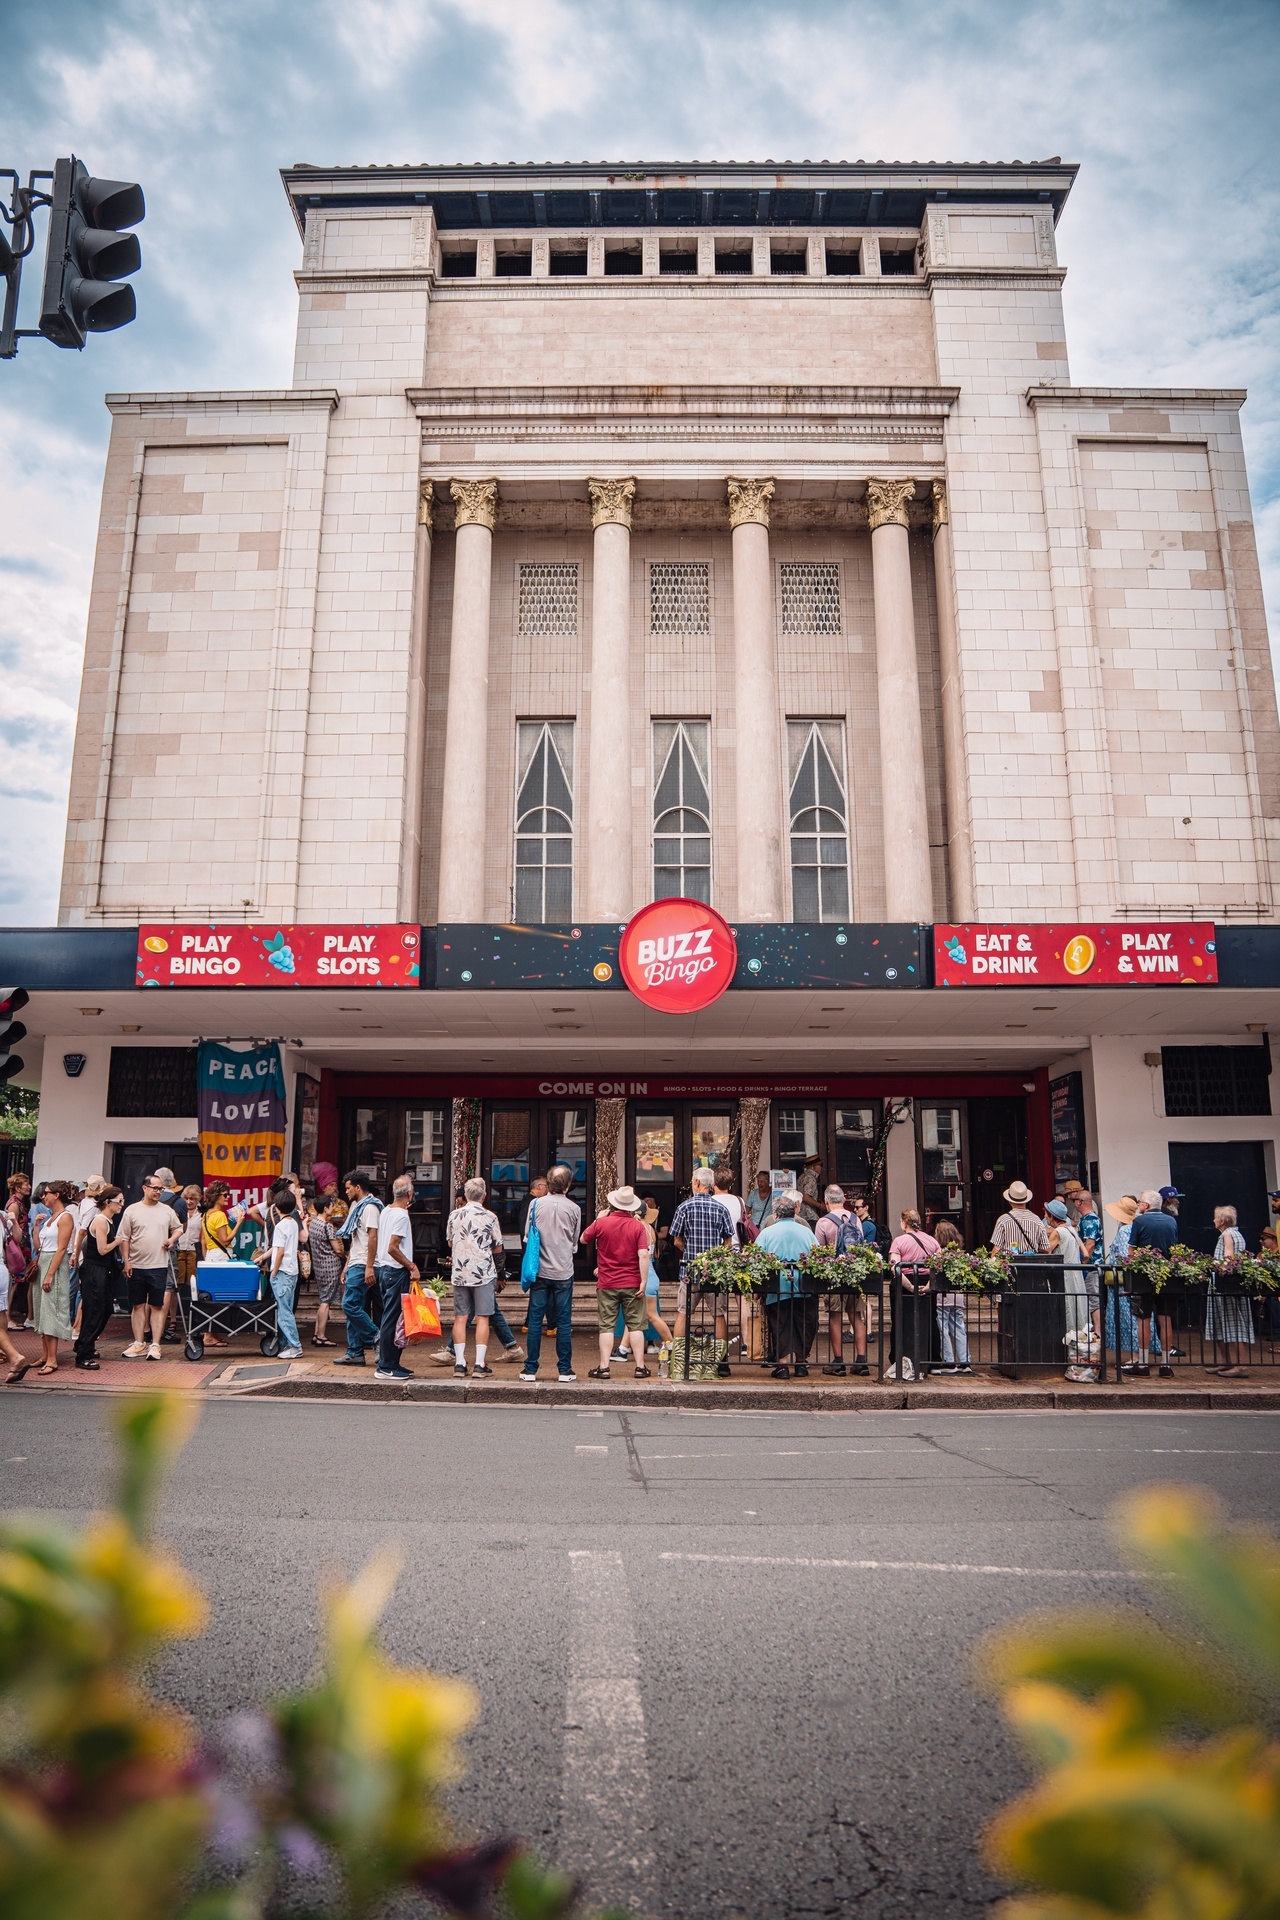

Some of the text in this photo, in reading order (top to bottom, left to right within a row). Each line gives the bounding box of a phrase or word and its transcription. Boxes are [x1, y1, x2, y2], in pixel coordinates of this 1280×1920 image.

[181, 935, 232, 953] PLAY
[324, 935, 375, 953] PLAY
[404, 936, 416, 945] 58
[637, 928, 714, 966] BUZZ
[975, 934, 1032, 952] EAT &
[1121, 933, 1172, 951] PLAY
[170, 957, 241, 975] BINGO
[316, 957, 380, 975] SLOTS
[644, 955, 717, 987] Bingo
[972, 956, 1038, 974] DRINK
[1117, 955, 1179, 973] & WIN
[538, 1082, 648, 1095] COME ON IN
[1051, 1086, 1070, 1100] SATURDAY
[210, 1099, 271, 1120] LOVE
[1052, 1097, 1068, 1109] EVENING
[202, 1143, 283, 1162] LOWER
